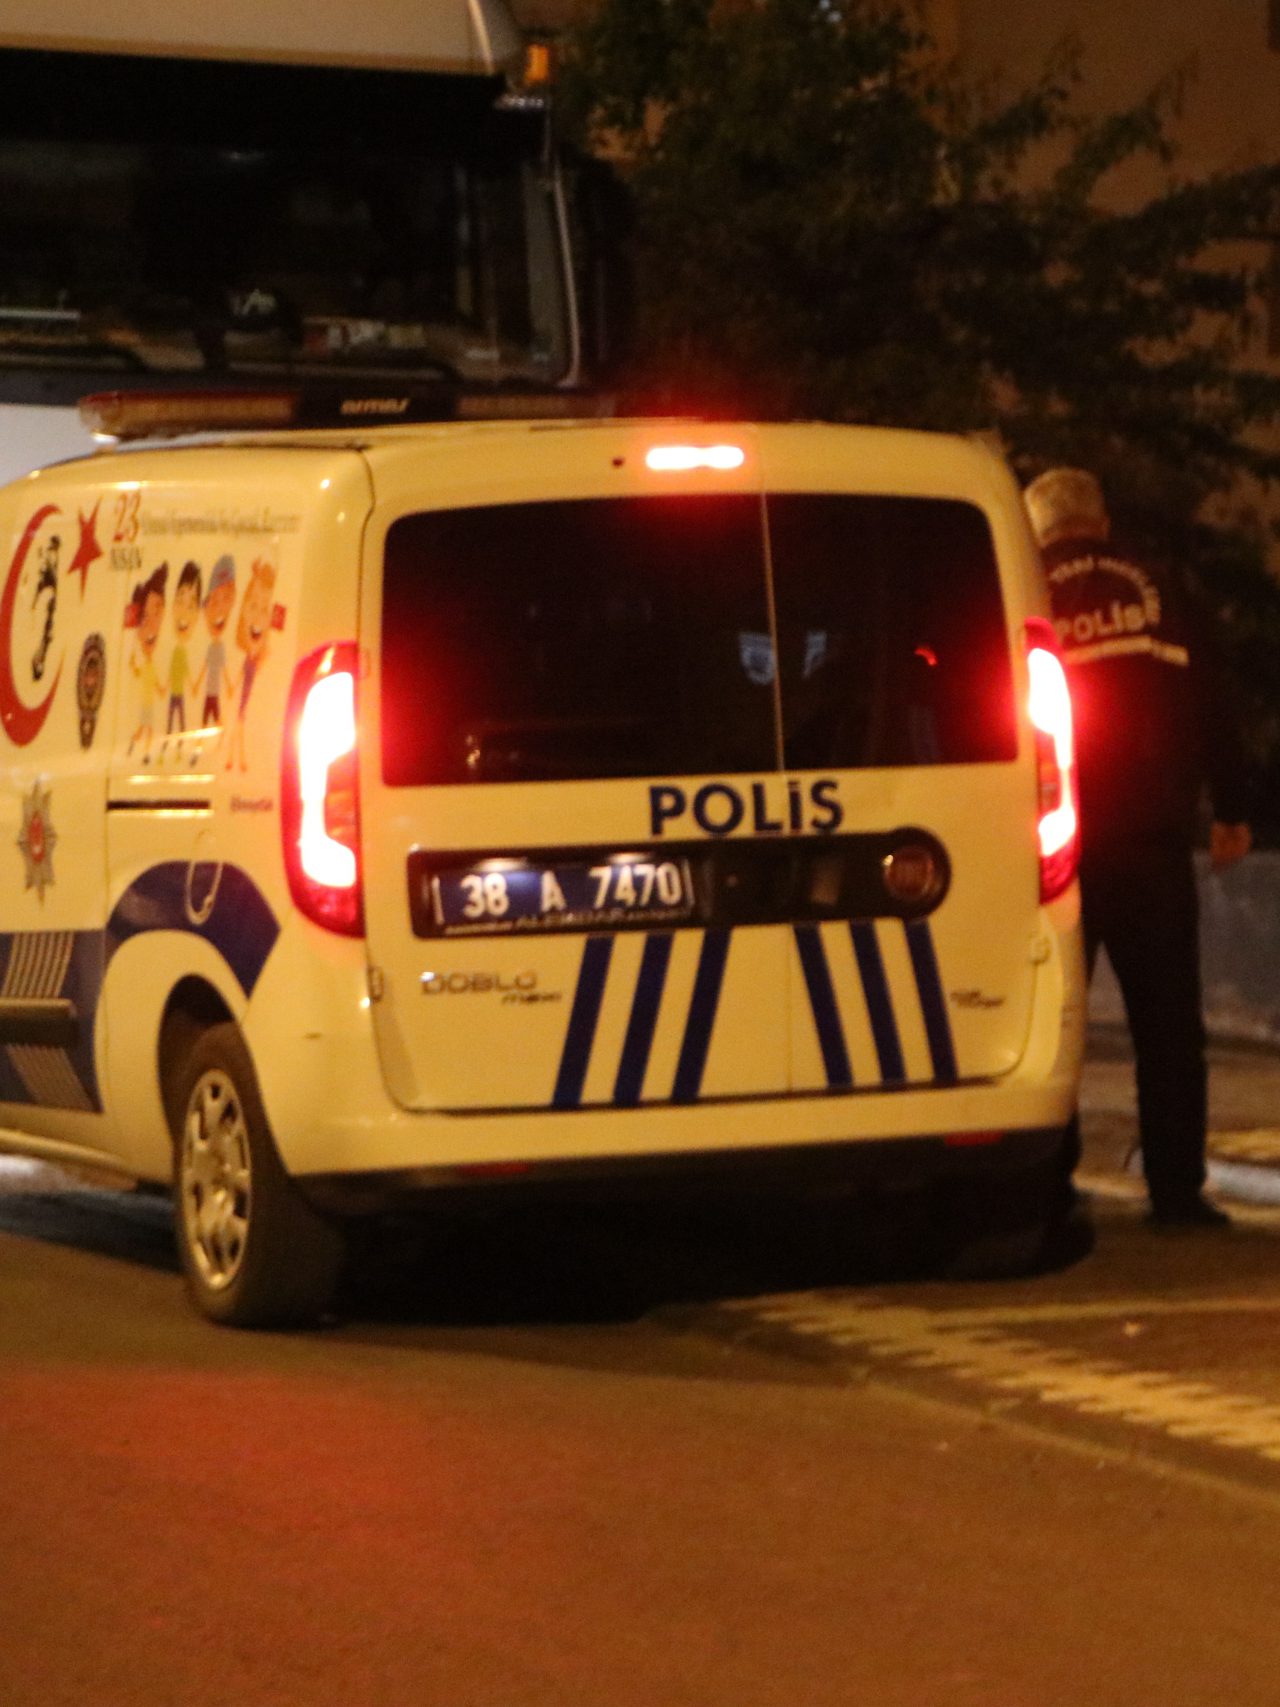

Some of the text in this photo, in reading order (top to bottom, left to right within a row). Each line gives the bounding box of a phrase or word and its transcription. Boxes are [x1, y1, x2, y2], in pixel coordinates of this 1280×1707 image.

[113, 491, 141, 543] 23
[460, 862, 684, 919] 38 A 7470
